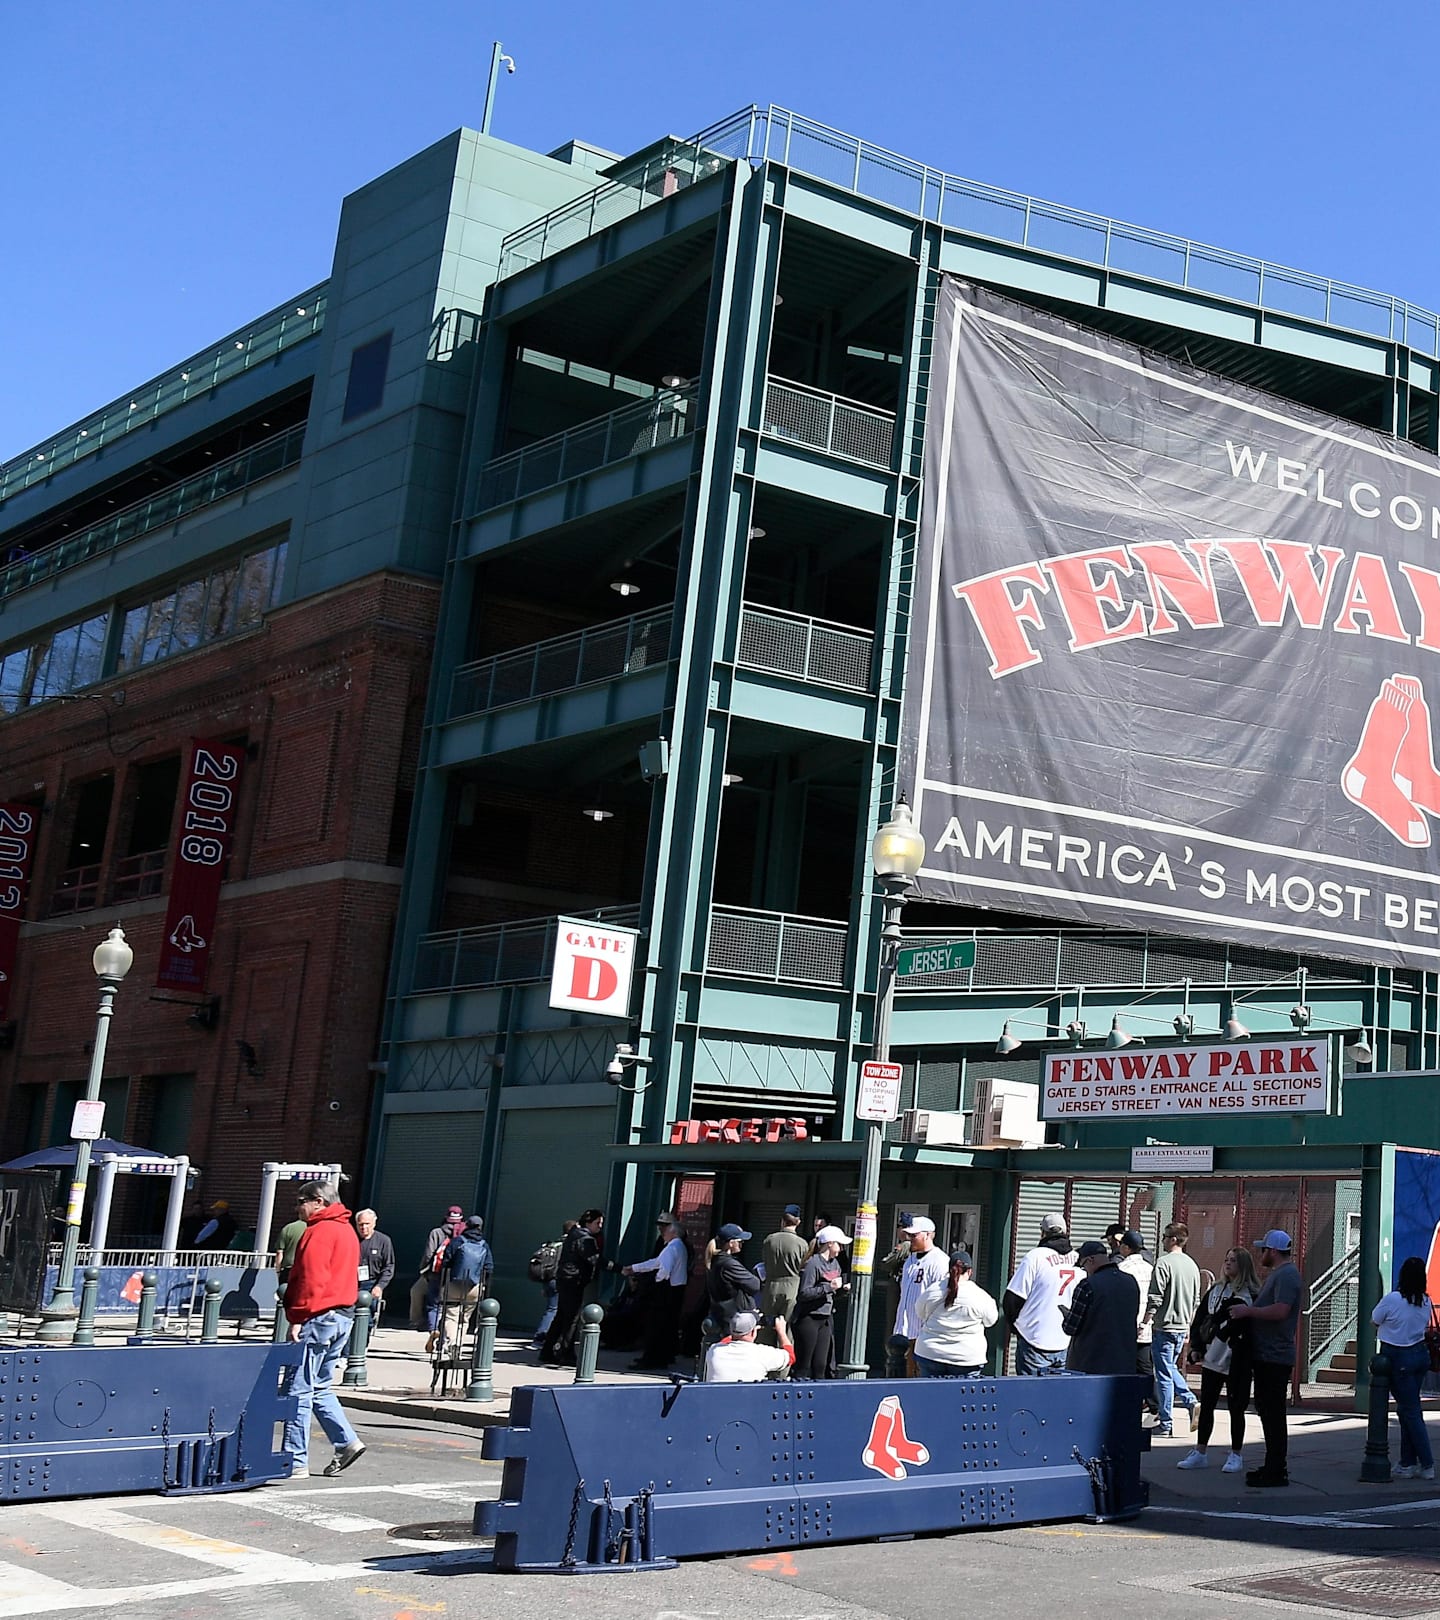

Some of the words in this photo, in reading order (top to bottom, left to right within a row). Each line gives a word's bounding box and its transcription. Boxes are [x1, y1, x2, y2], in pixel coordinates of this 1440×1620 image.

[181, 749, 238, 865] 2018
[933, 816, 1227, 899] AMERICA'S
[1245, 868, 1370, 921] MOST
[566, 932, 626, 953] GATE
[909, 948, 952, 974] JERSEY
[954, 956, 962, 968] ST
[566, 954, 618, 1001] D
[866, 1066, 881, 1077] TOW
[881, 1068, 899, 1079] ZONE
[1050, 1052, 1197, 1083] FENWAY
[1208, 1046, 1319, 1078] PARK
[864, 1087, 895, 1095] STOPPING
[873, 1080, 887, 1088] NO
[1047, 1087, 1077, 1099] GATE
[1082, 1086, 1090, 1098] D
[1095, 1085, 1136, 1097] STAIRS
[1150, 1081, 1217, 1094] ENTRANCE
[1222, 1079, 1247, 1092] ALL
[1253, 1077, 1322, 1091] SECTIONS
[1057, 1100, 1106, 1113] JERSEY
[1111, 1099, 1160, 1111] STREET
[1178, 1097, 1202, 1109] VAN
[1209, 1096, 1245, 1108] NESS
[1251, 1094, 1307, 1107] STREET
[670, 1118, 808, 1145] TICKETS
[1157, 1149, 1192, 1157] ENTRANCE
[1058, 1269, 1075, 1296] 7
